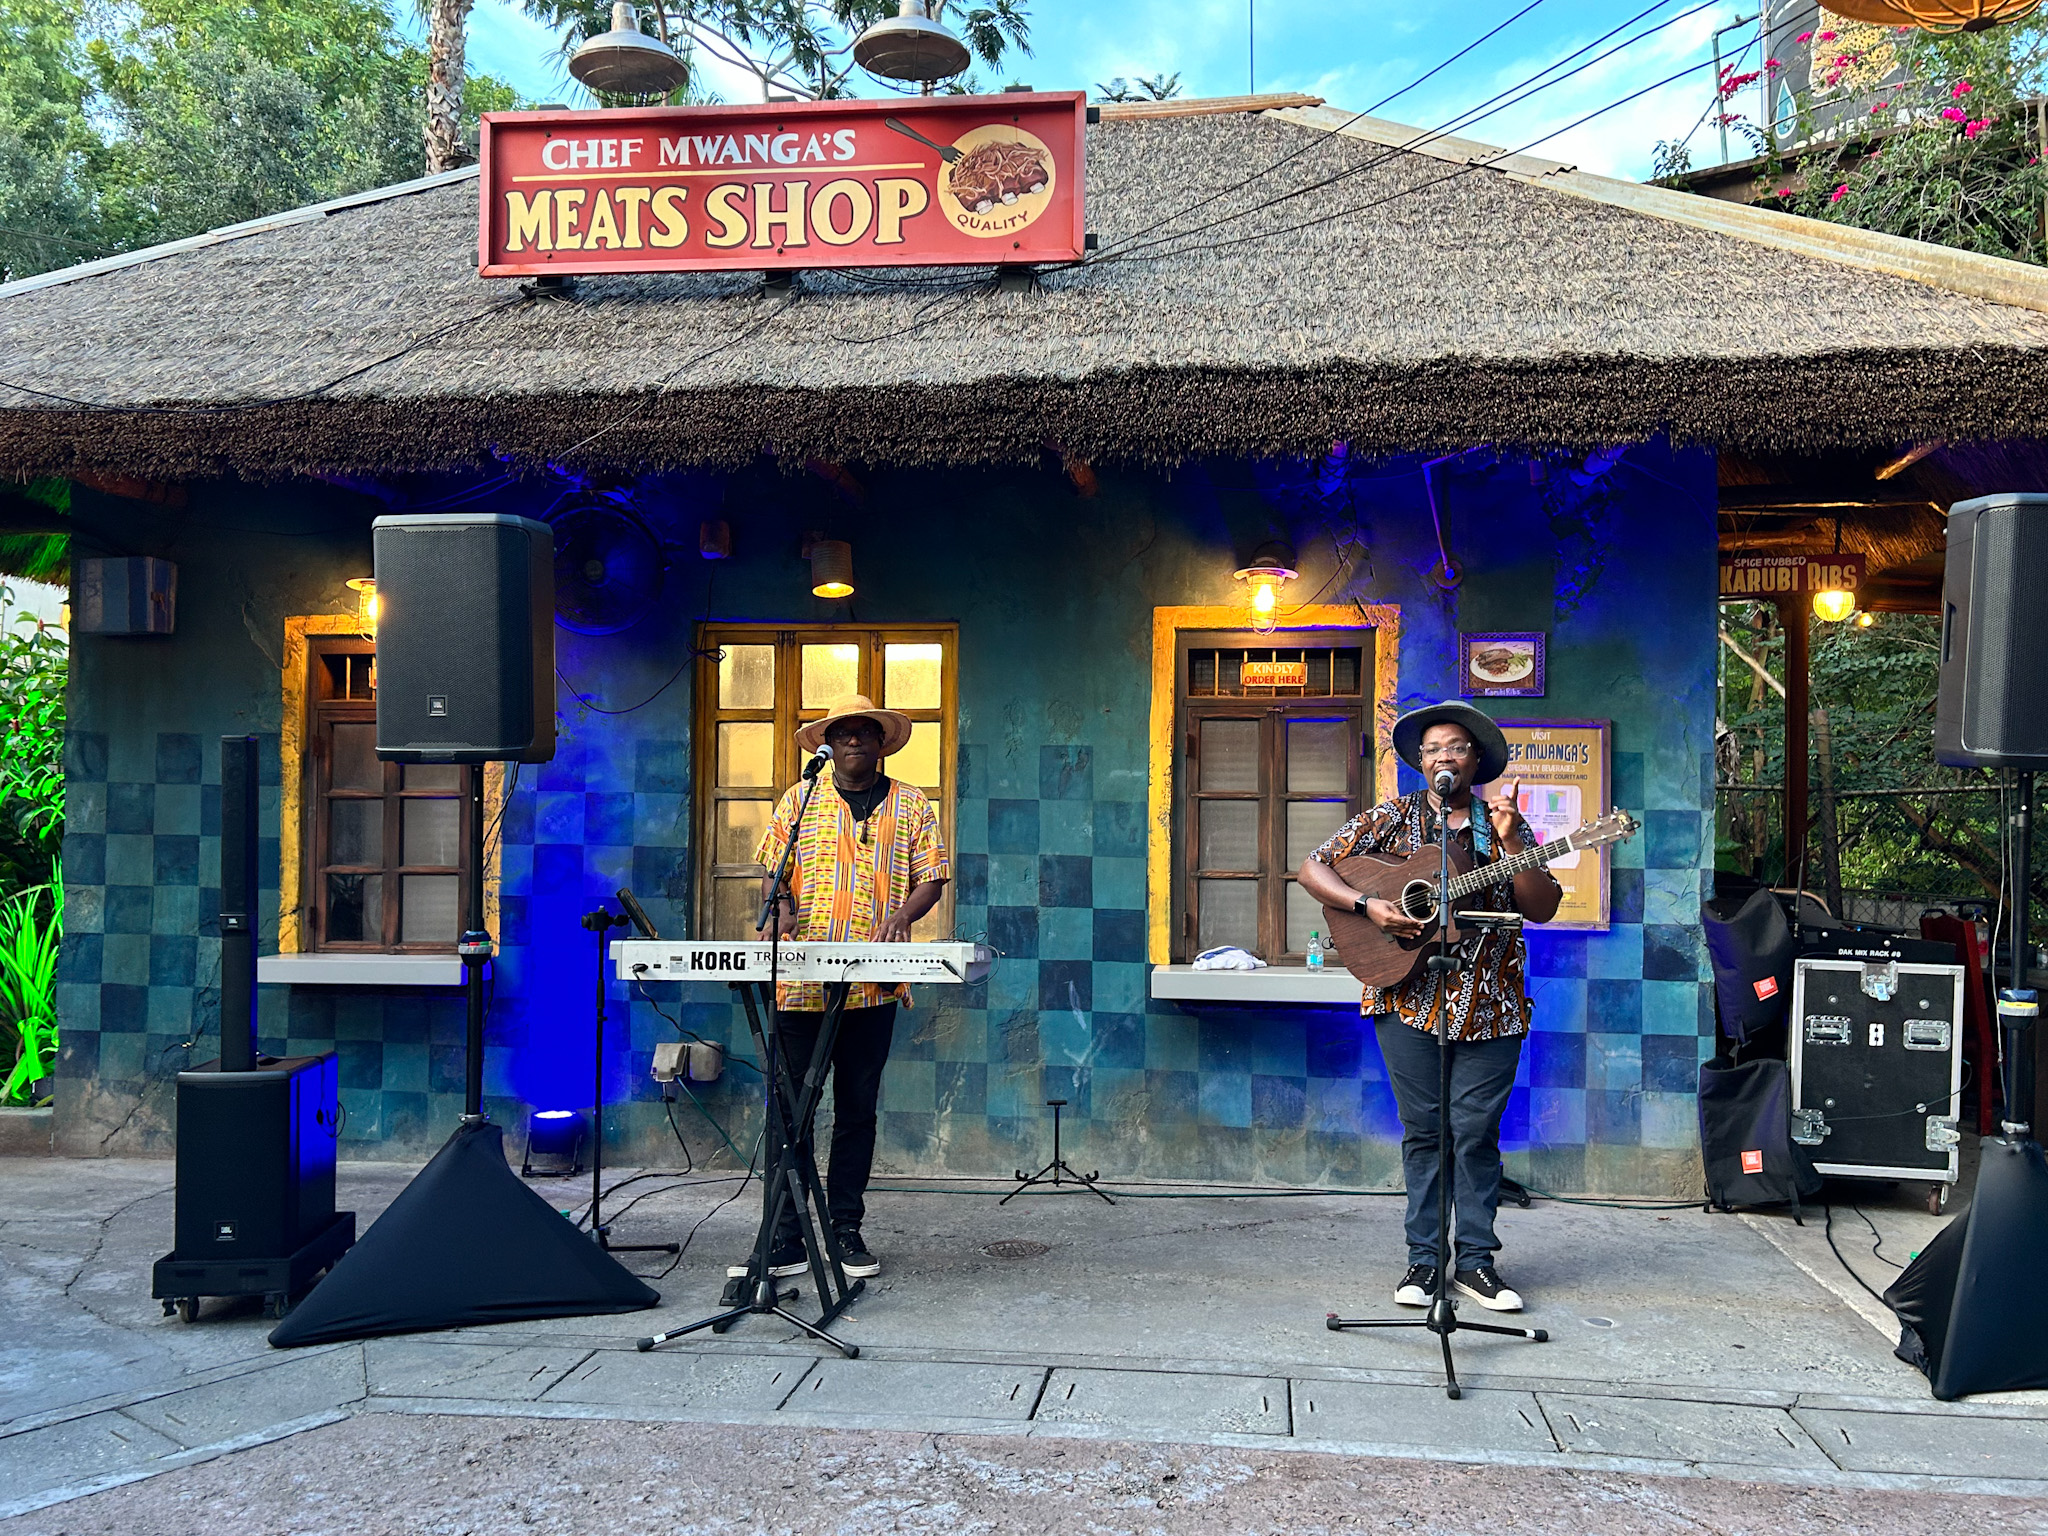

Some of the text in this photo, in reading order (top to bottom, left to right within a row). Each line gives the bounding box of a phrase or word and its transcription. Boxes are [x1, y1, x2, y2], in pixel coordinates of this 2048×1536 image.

[542, 129, 856, 170] CHEF MWANGA'S
[503, 177, 931, 252] MEATS SHOP
[957, 210, 1028, 231] QUALITY
[1734, 556, 1807, 568] SPICE RUBBED
[1719, 562, 1858, 594] KARUBI RIBS
[1253, 664, 1295, 674] KINDLY
[1244, 675, 1304, 684] ORDER HERE
[1531, 731, 1551, 740] VISIT
[1507, 742, 1589, 766] EF MWANGA'S
[1507, 764, 1576, 772] SPECIALTY BEVERAGES
[691, 951, 806, 970] KORG TRTON
